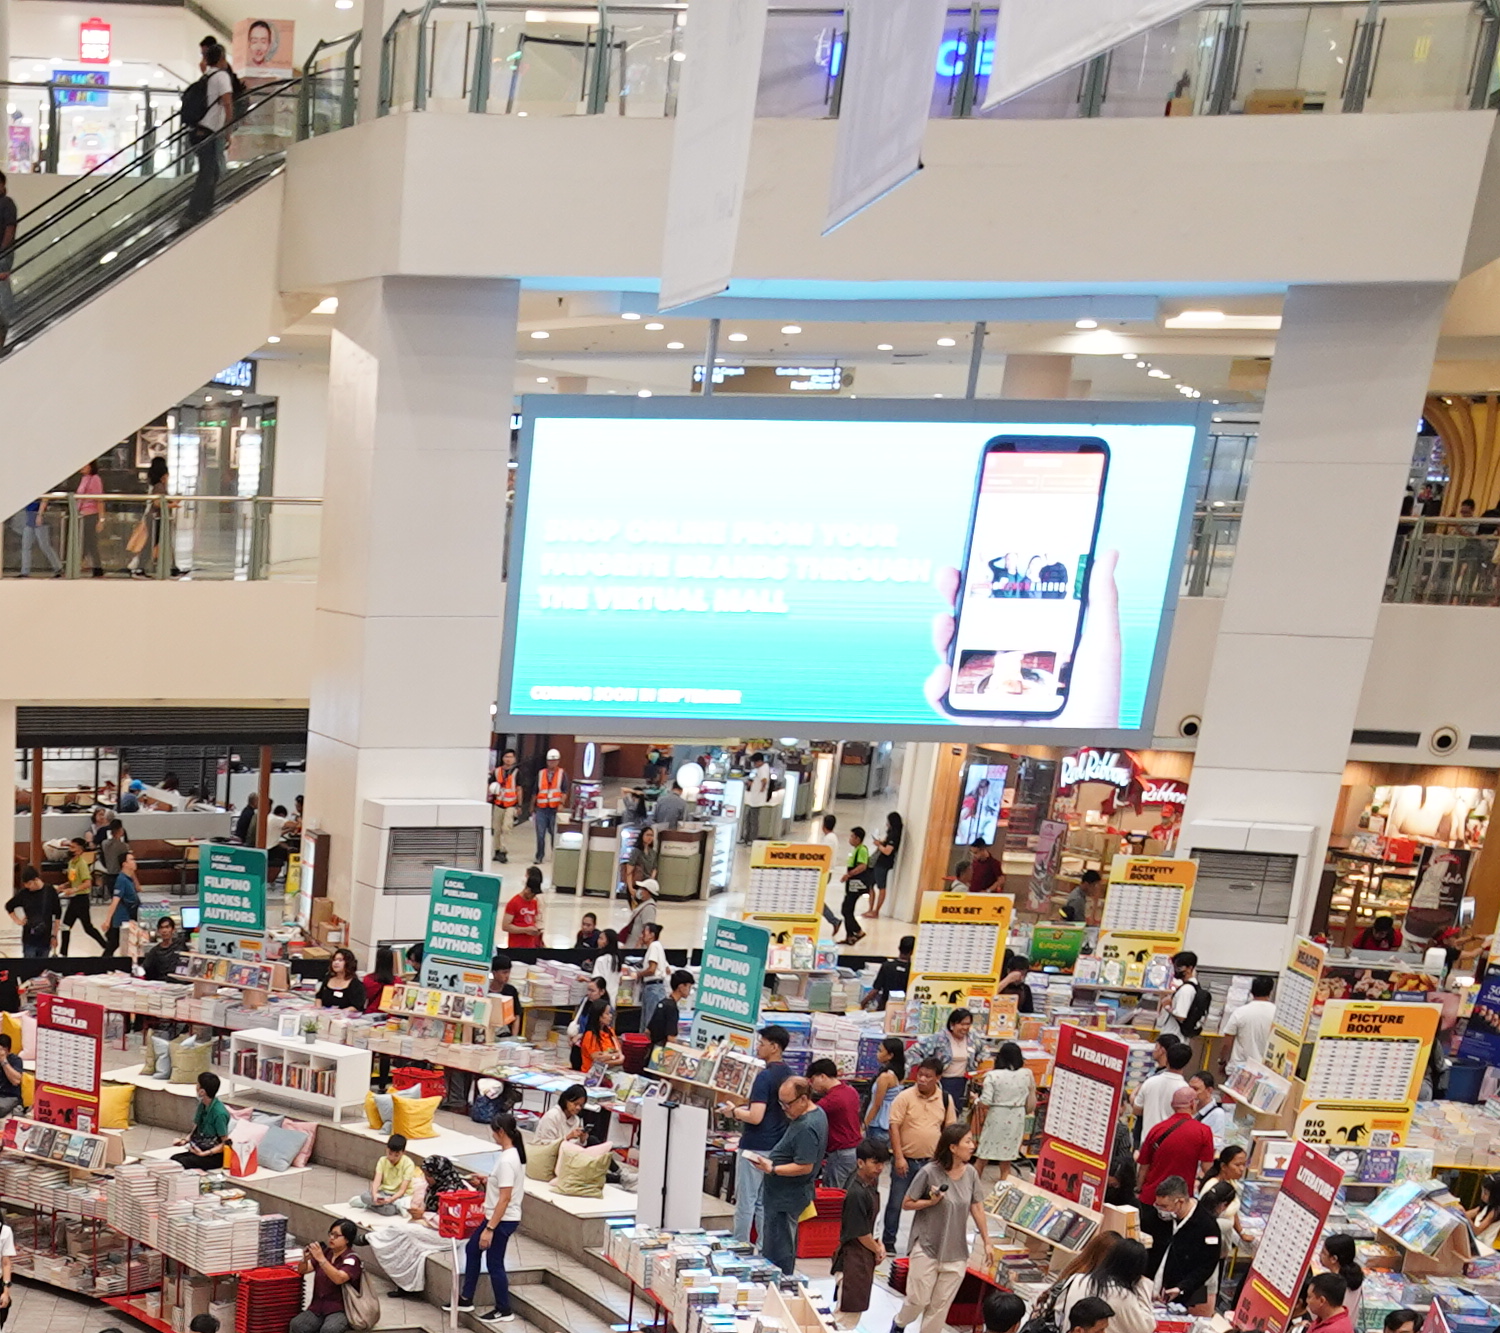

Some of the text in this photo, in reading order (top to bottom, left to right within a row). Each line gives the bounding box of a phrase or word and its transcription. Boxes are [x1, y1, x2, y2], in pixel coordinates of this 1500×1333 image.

[545, 519, 898, 549] SHOP ONLINE FROM YOUR
[677, 555, 788, 582] BRANDS
[796, 557, 931, 585] THROUGH
[539, 586, 587, 610] THE
[714, 590, 788, 614] MALL
[769, 851, 826, 862] WORK BOOK
[1130, 873, 1156, 881] BOOK
[1131, 865, 1175, 875] ACTIVITY
[204, 875, 250, 893] FILIPINO
[204, 892, 251, 909] BOOKS &
[204, 907, 257, 925] AUTHORS
[433, 903, 482, 921] FILIPINO
[941, 905, 983, 916] BOX SET
[431, 920, 479, 939] BOOKS &
[429, 936, 483, 955] AUTHORS
[705, 953, 751, 977] FILIPINO
[703, 973, 747, 997] BOOKS &
[51, 1005, 76, 1018] CRIME
[701, 991, 750, 1016] AUTHORS
[51, 1014, 88, 1030] THRILLER
[1347, 1023, 1381, 1034] BOOK
[1349, 1013, 1405, 1026] PICTURE
[1072, 1043, 1123, 1072] LITERATURE
[1303, 1128, 1327, 1139] BAD
[1305, 1119, 1324, 1130] BIG
[1295, 1167, 1335, 1198] LITERATURE
